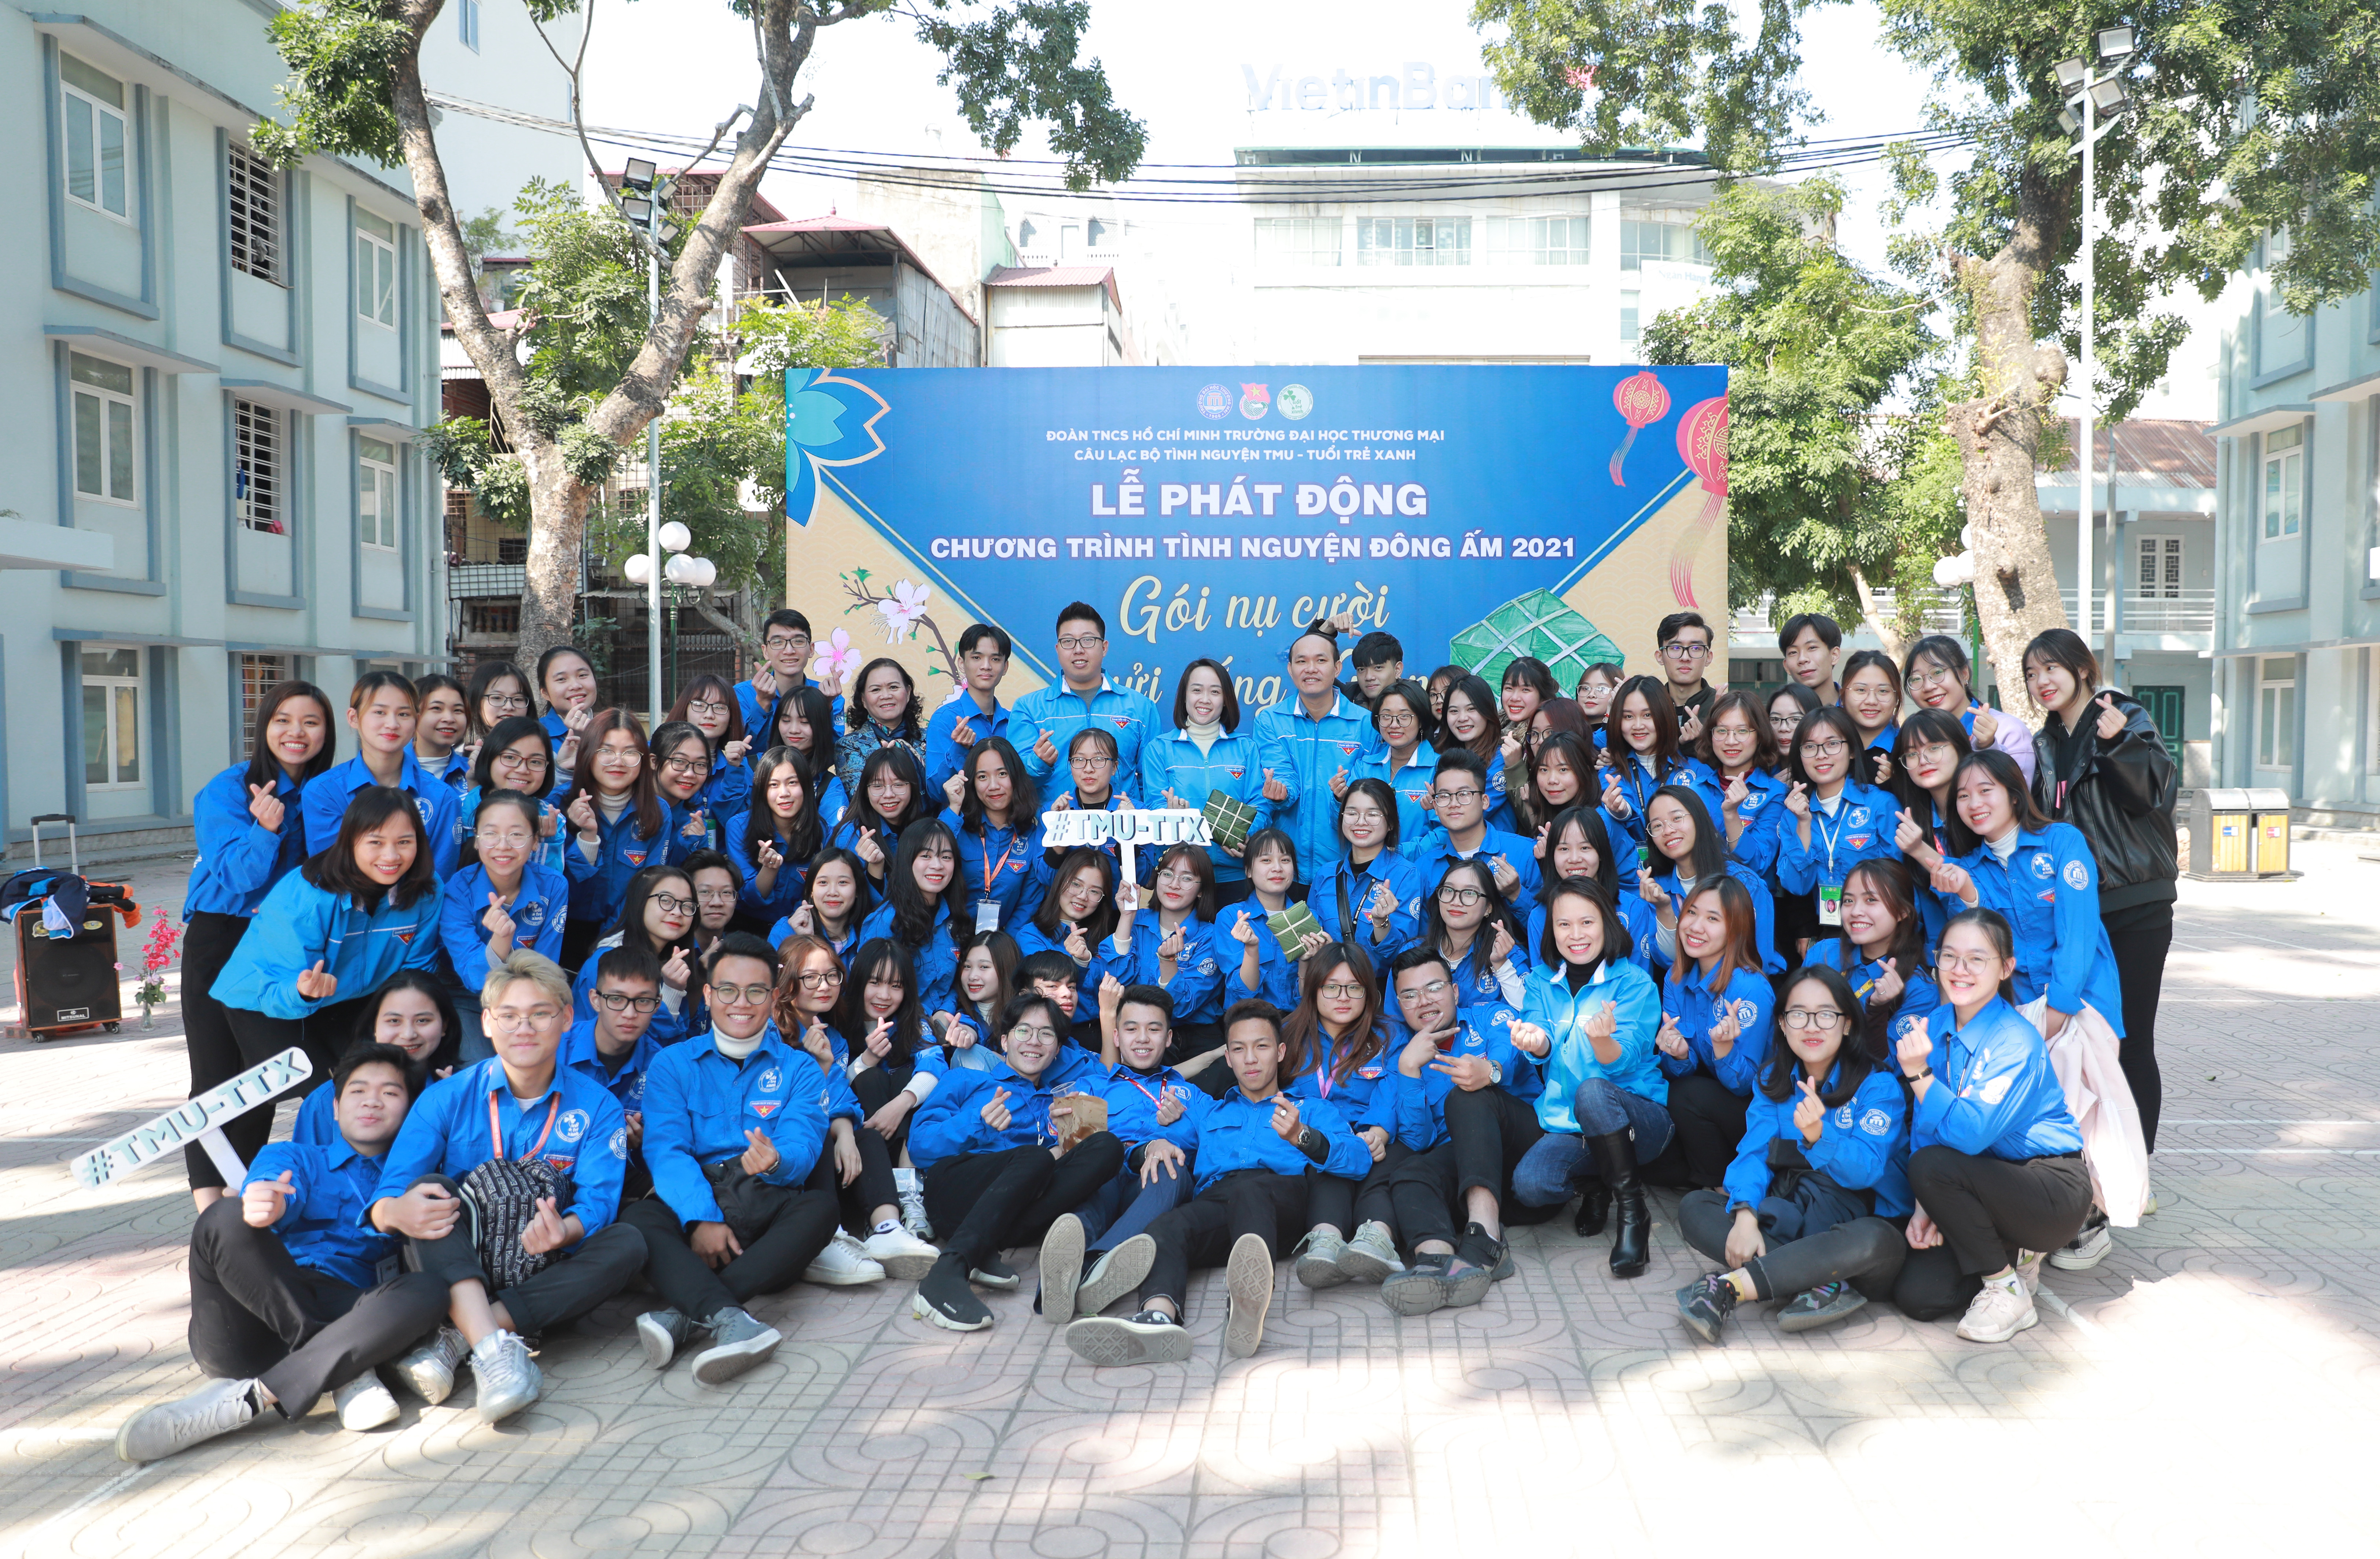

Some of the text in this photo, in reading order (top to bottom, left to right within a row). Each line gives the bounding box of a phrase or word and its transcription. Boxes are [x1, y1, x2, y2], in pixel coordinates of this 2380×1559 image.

[1241, 62, 1527, 111] VietinBan
[1046, 426, 1444, 443] ĐOÀN TNCS HỒ CHÍ MINH TRƯỜNG ĐẠI HỌC THƯƠNG MẠI
[1074, 447, 1105, 461] CÂU
[1108, 450, 1137, 463] LẠC
[1140, 447, 1161, 463] BỘ
[1164, 447, 1197, 460] TÌNH
[1201, 447, 1260, 463] NGUYỆN
[1263, 450, 1294, 461] TMU
[1306, 444, 1340, 460] TUỔI
[1344, 446, 1371, 460] TRẺ
[1374, 450, 1415, 460] XANH
[1092, 468, 1426, 524] LỄ PHÁT ĐỘNG
[931, 530, 1573, 563] CHƯƠNG TRÌNH TÌNH NGUYỆN ĐÔNG ẤM 2021
[1119, 575, 1211, 645] Gói
[1226, 595, 1281, 638] nụ
[1047, 812, 1206, 843] #TMU-TTX
[82, 1049, 306, 1187] #TMU-TTX
[497, 1204, 506, 1233] Escstudio
[518, 1204, 528, 1235] Escstudio
[493, 1235, 504, 1266] Escstudio
